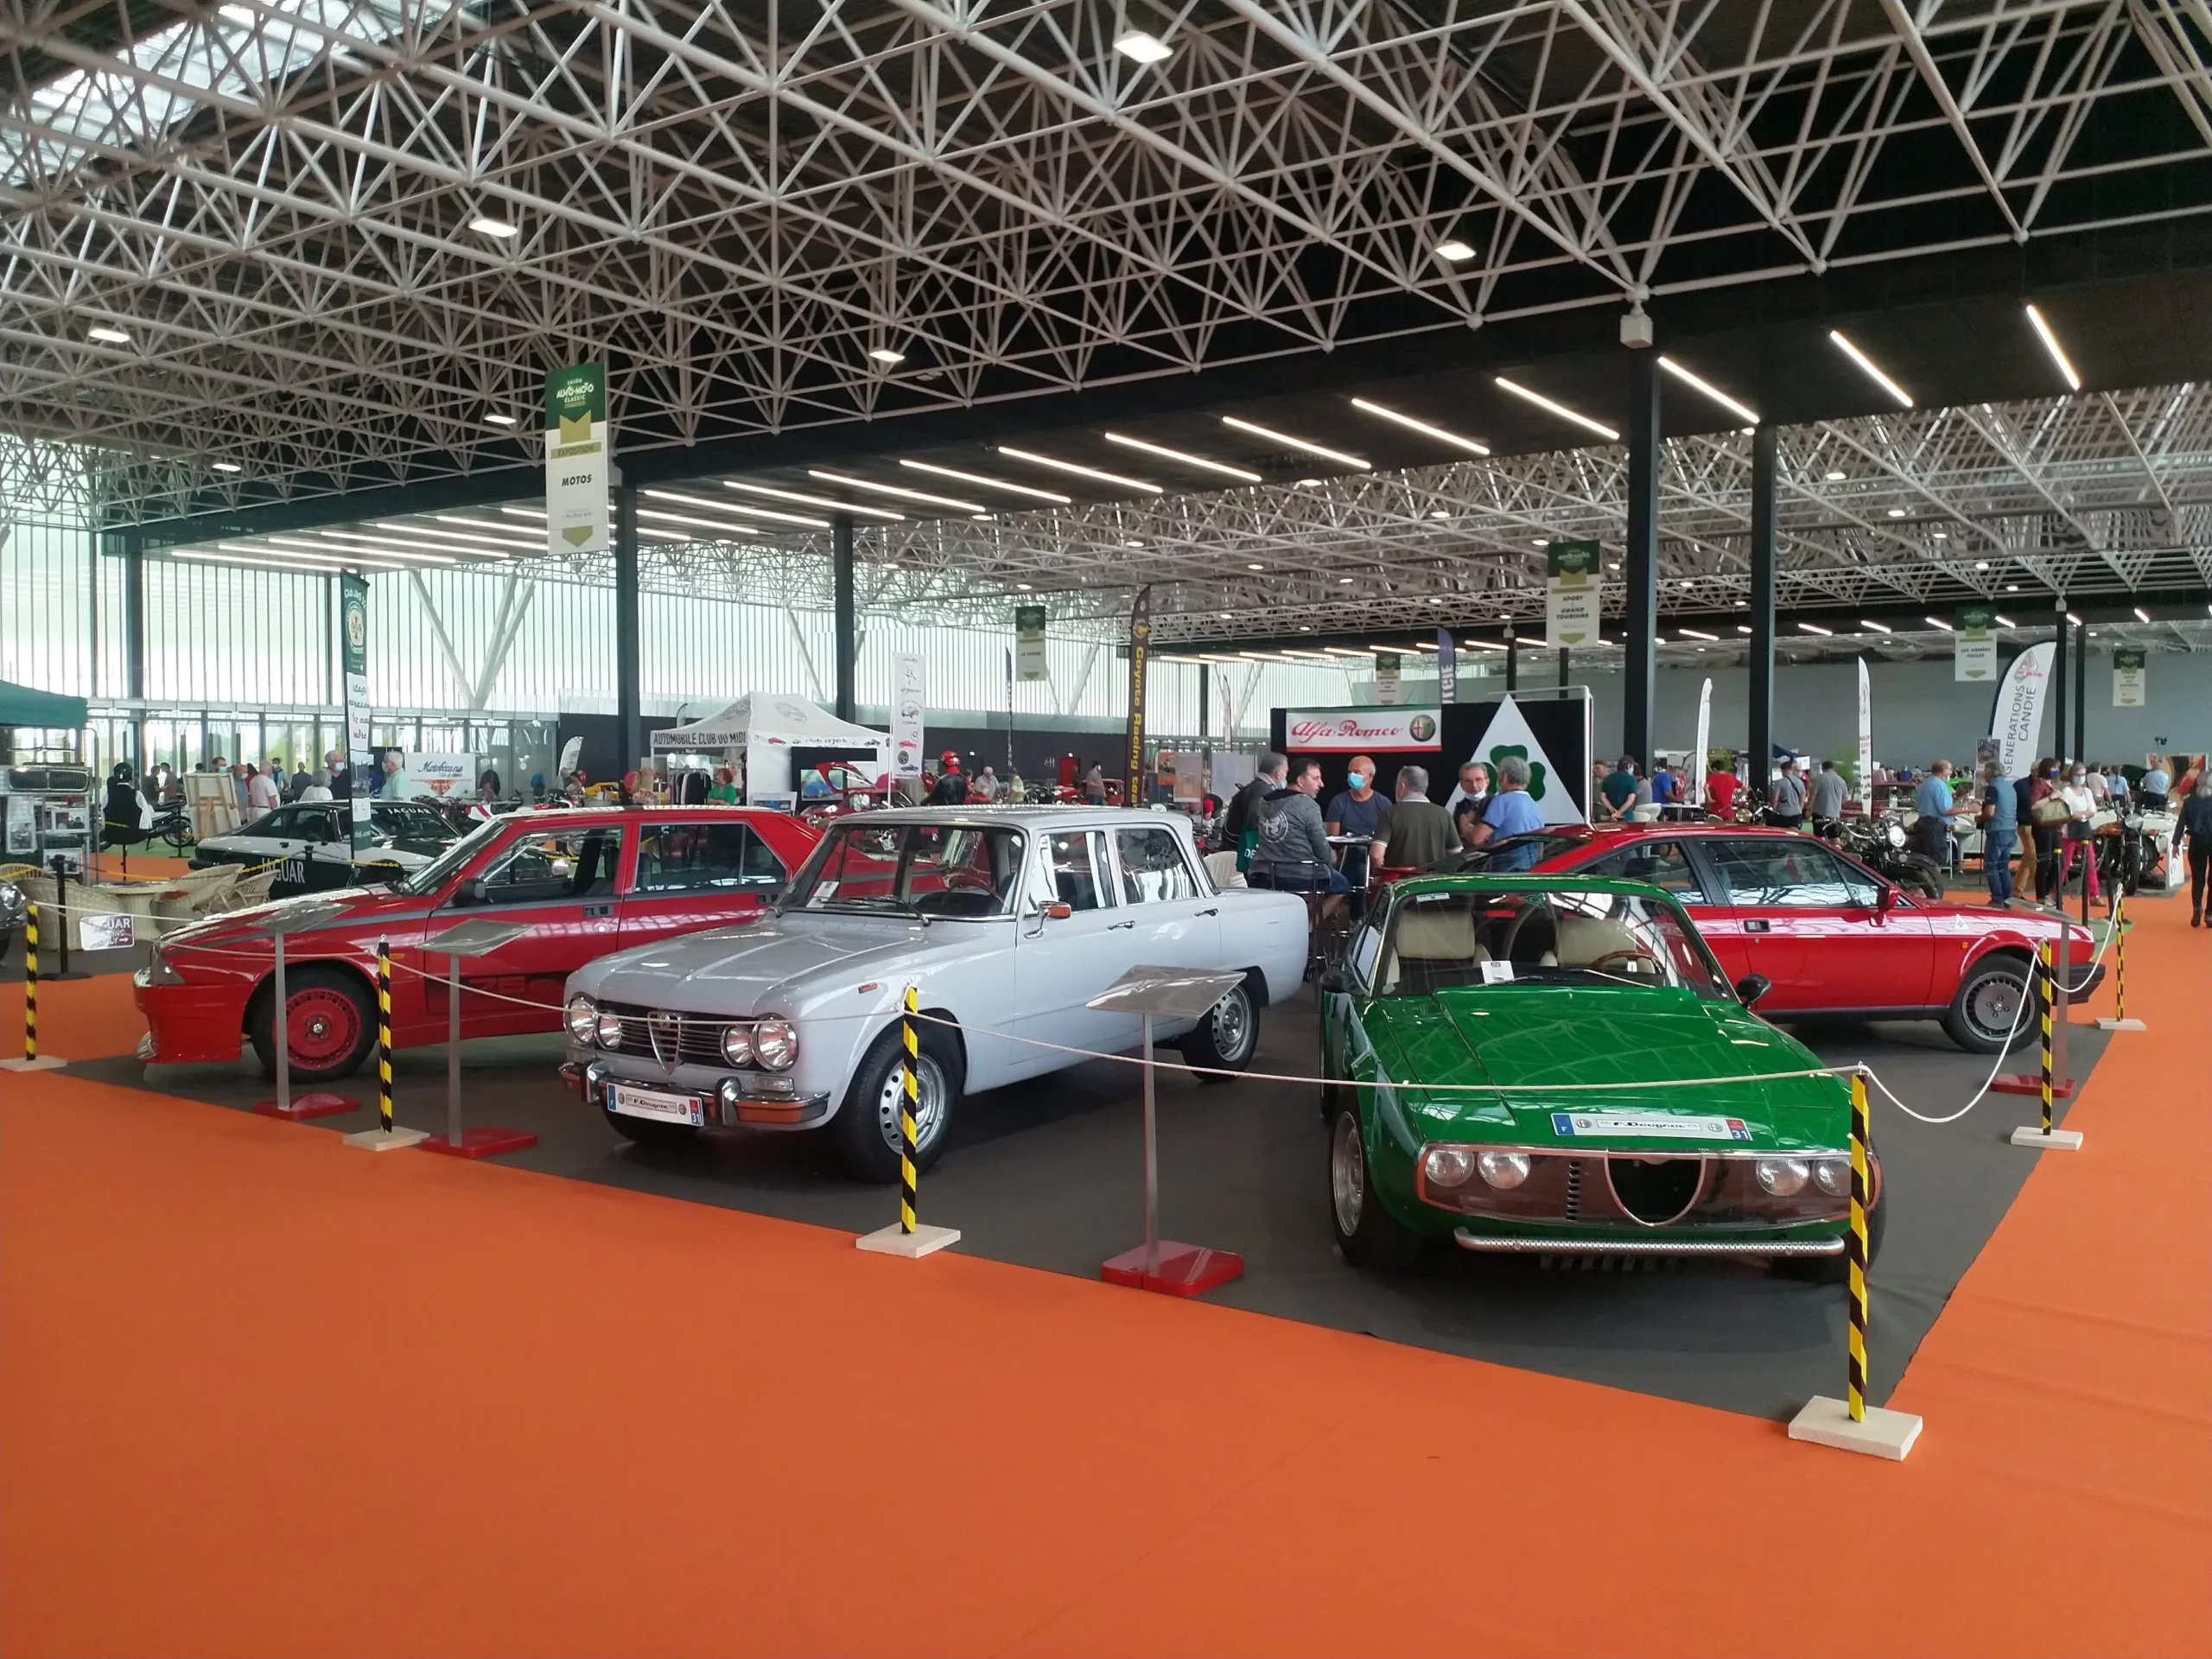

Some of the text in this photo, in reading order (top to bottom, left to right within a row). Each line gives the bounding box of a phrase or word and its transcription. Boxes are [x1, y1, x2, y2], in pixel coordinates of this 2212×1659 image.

[561, 474, 592, 486] MOTOS
[1134, 646, 1144, 707] Coyote
[654, 731, 746, 745] AUTOMOBILE CLUB DU MIDI
[1291, 719, 1403, 744] Alfa Romeo
[2004, 685, 2024, 774] GENERATIONS
[2018, 688, 2036, 741] CANDIE
[1130, 713, 1142, 770] Racing
[691, 1112, 701, 1123] 31
[1732, 1130, 1748, 1140] 31
